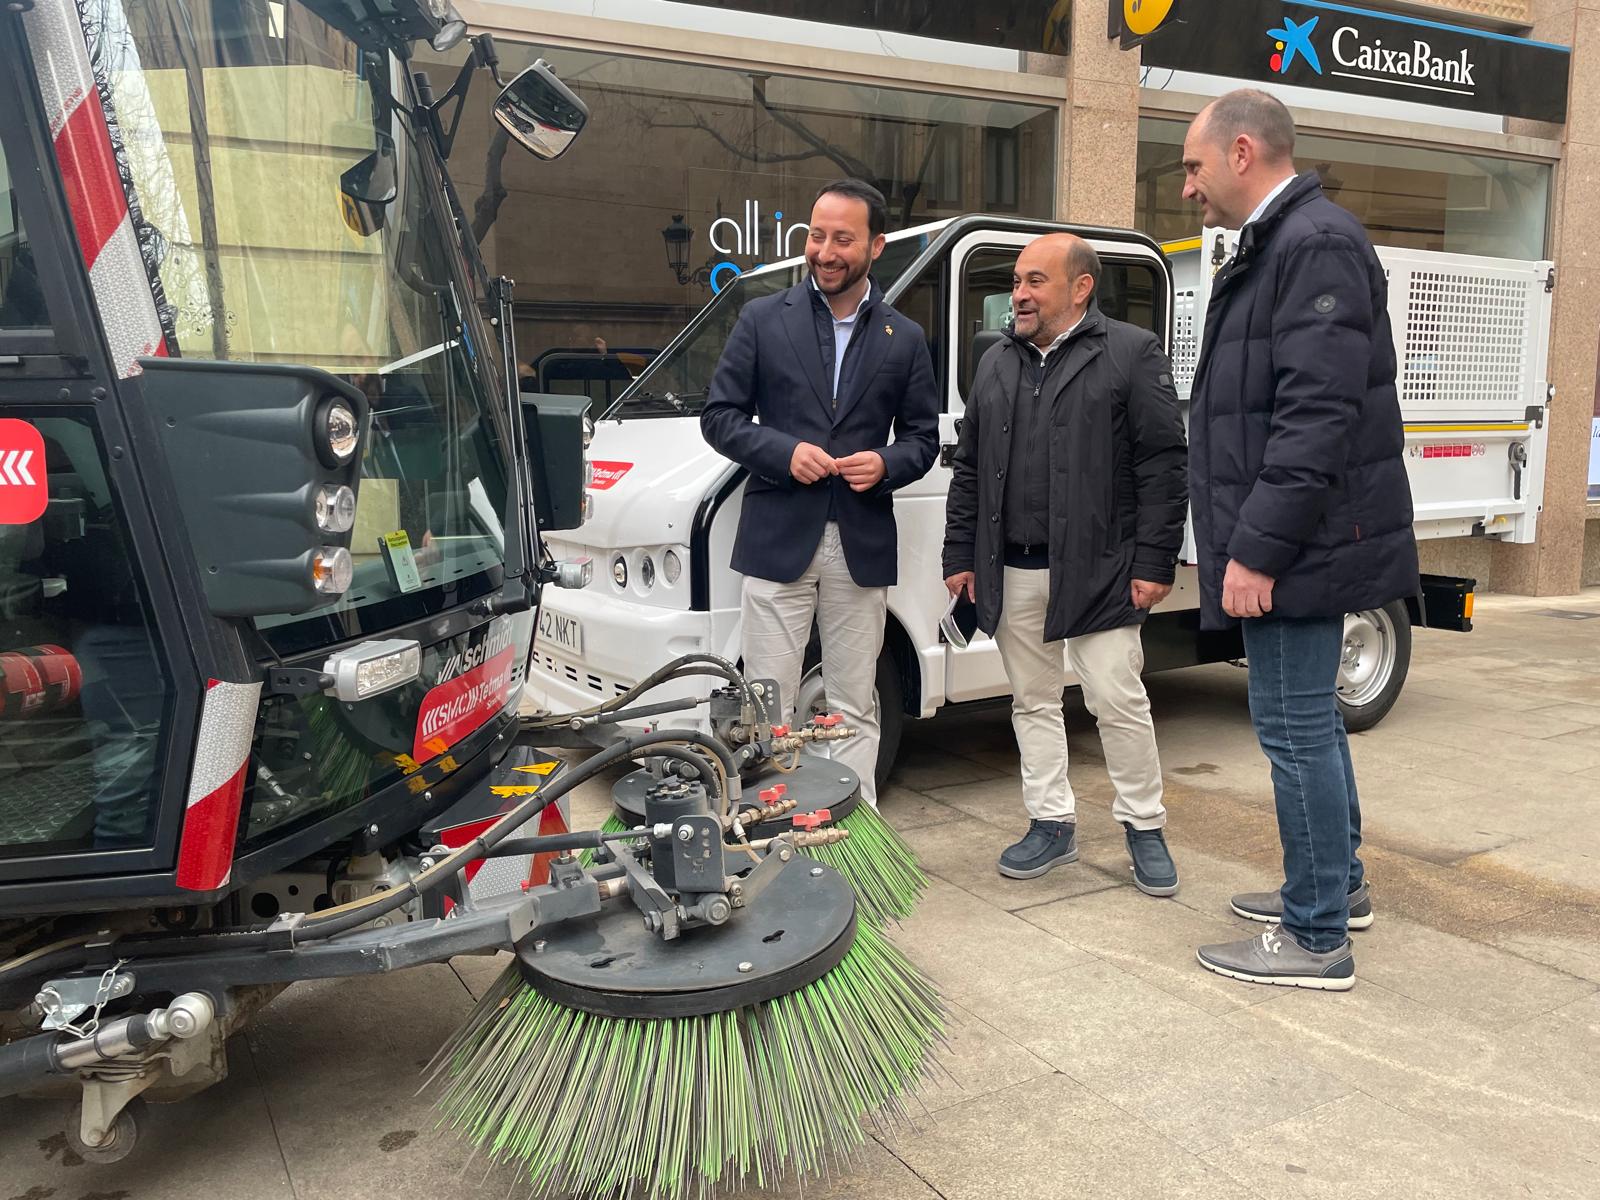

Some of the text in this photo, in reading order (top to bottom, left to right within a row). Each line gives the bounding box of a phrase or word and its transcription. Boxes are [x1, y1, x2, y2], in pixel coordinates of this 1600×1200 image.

[1331, 26, 1476, 86] CaixaBank
[709, 199, 759, 256] all
[555, 614, 577, 648] NKT
